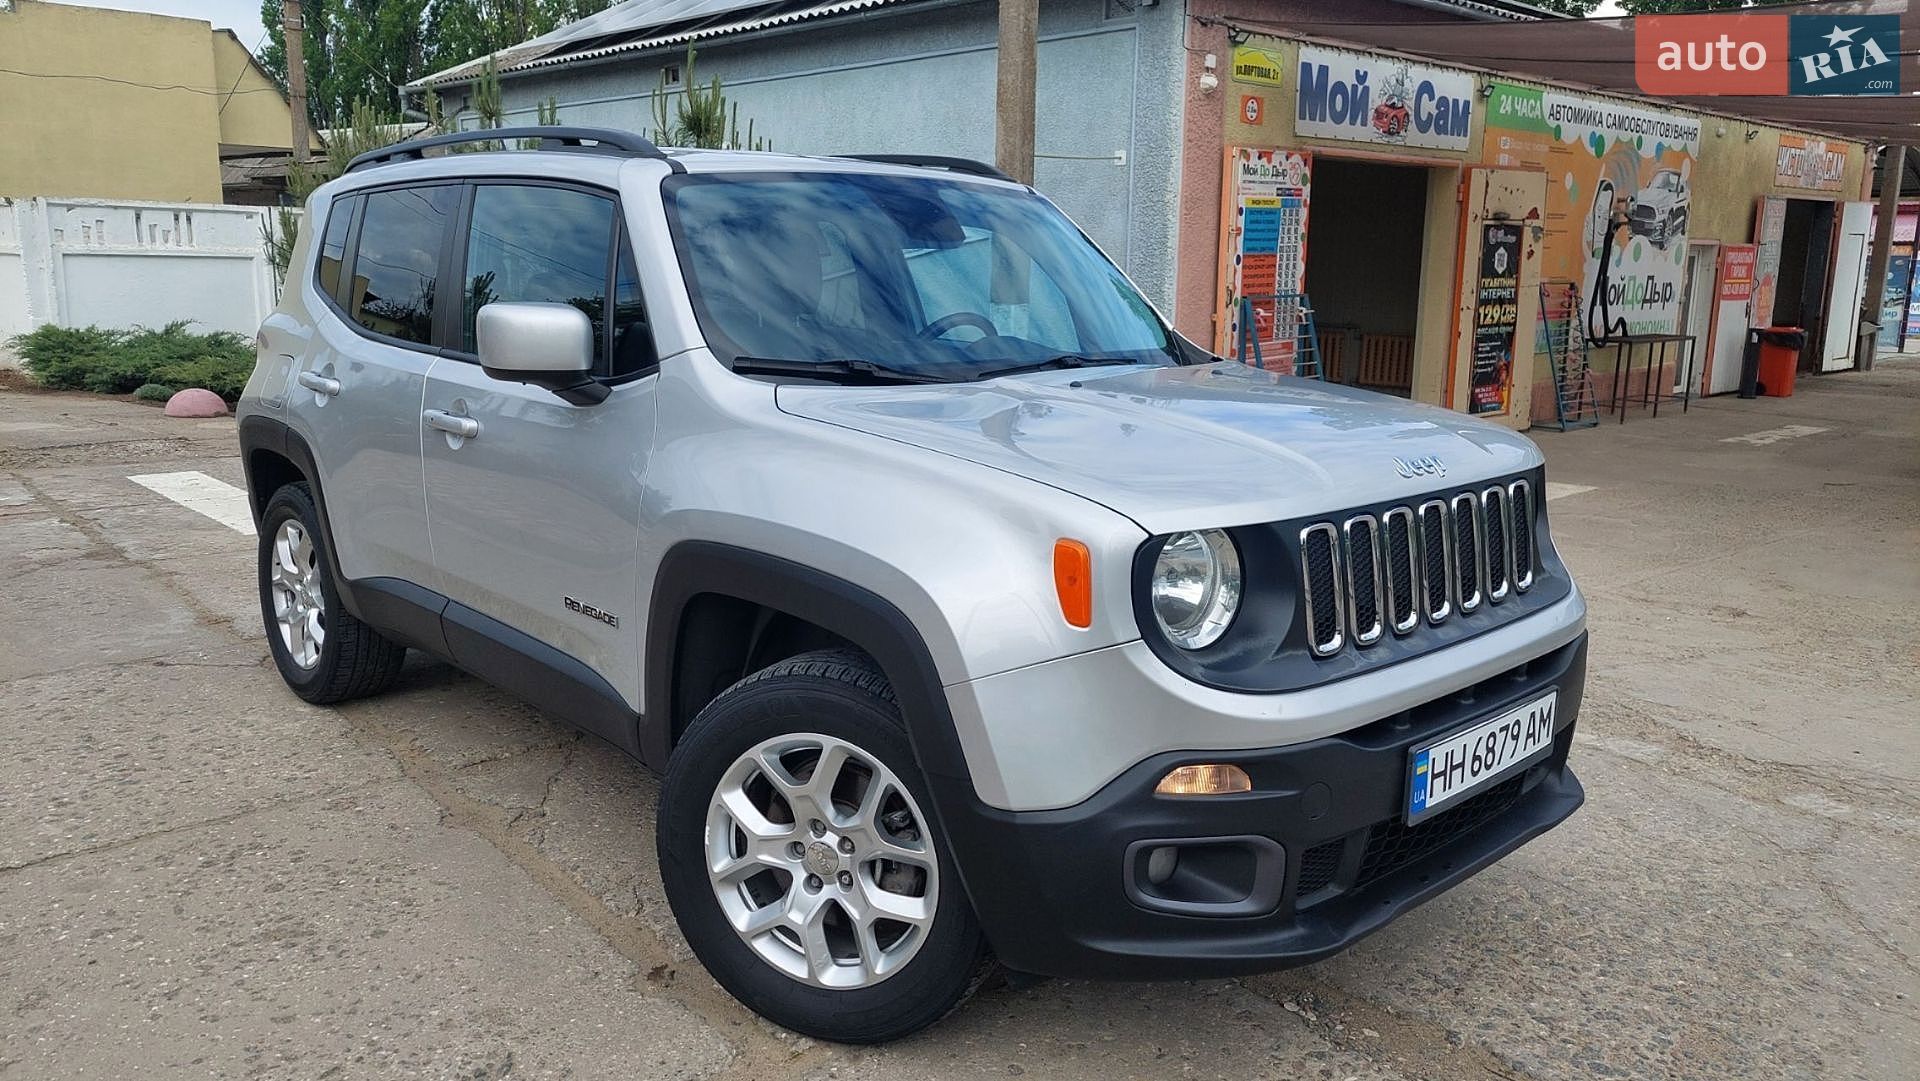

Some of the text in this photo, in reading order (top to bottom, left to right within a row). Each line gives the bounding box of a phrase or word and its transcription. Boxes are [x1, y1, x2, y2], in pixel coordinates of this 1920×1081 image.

[1299, 61, 1471, 138] Мой Сам
[1500, 94, 1542, 119] 24 ЧАСА
[1548, 103, 1699, 141] АВТОМИЙКА САМООБСЛУГОВУВАННЯ
[1242, 163, 1288, 180] Мой До Дыр
[1480, 288, 1515, 299] ІНТЕРНЕТ
[1479, 304, 1501, 326] 129
[1392, 456, 1446, 479] Jeep
[564, 596, 616, 627] RENEGADE
[1470, 718, 1521, 777] 6879
[1523, 701, 1552, 751] AM
[1414, 791, 1425, 804] UA
